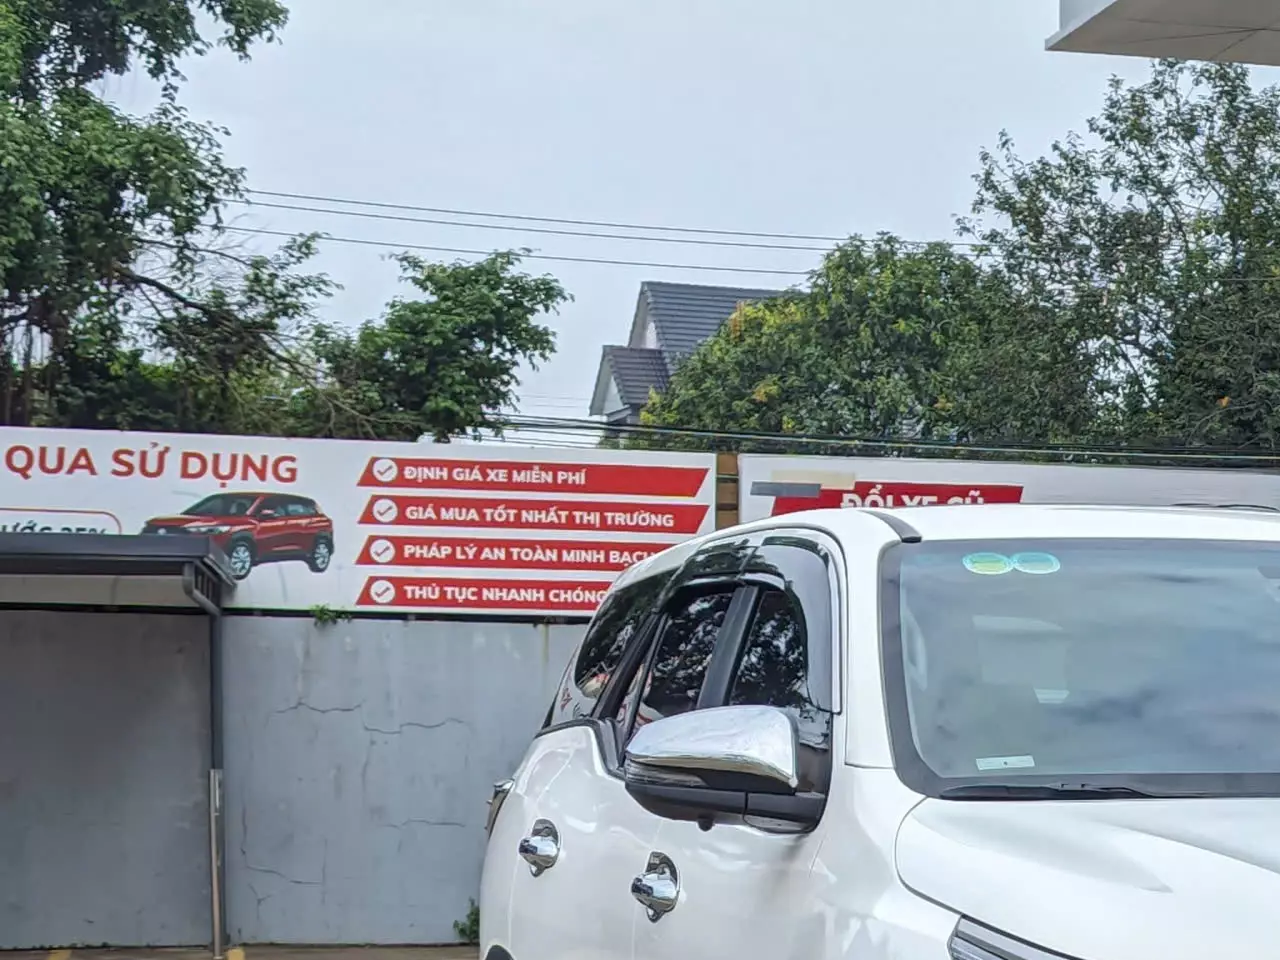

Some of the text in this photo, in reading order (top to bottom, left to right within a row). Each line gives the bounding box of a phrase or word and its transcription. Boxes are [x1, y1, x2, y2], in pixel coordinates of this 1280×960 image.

[5, 442, 298, 487] QUA SỬ DỤNG
[403, 465, 587, 484] ĐỊNH GIÁ XE MIỄN PHÍ
[405, 504, 674, 527] GIÁ MUA TỐT NHẤT THỊ TRƯỜNG
[403, 542, 452, 559] PHÁP
[455, 544, 478, 559] LÝ
[480, 547, 506, 560] AN
[510, 545, 558, 562] TOÀN
[562, 549, 605, 563] MINH
[403, 583, 440, 599] THỦ
[443, 586, 478, 602] TỤC
[482, 587, 545, 602] NHANH
